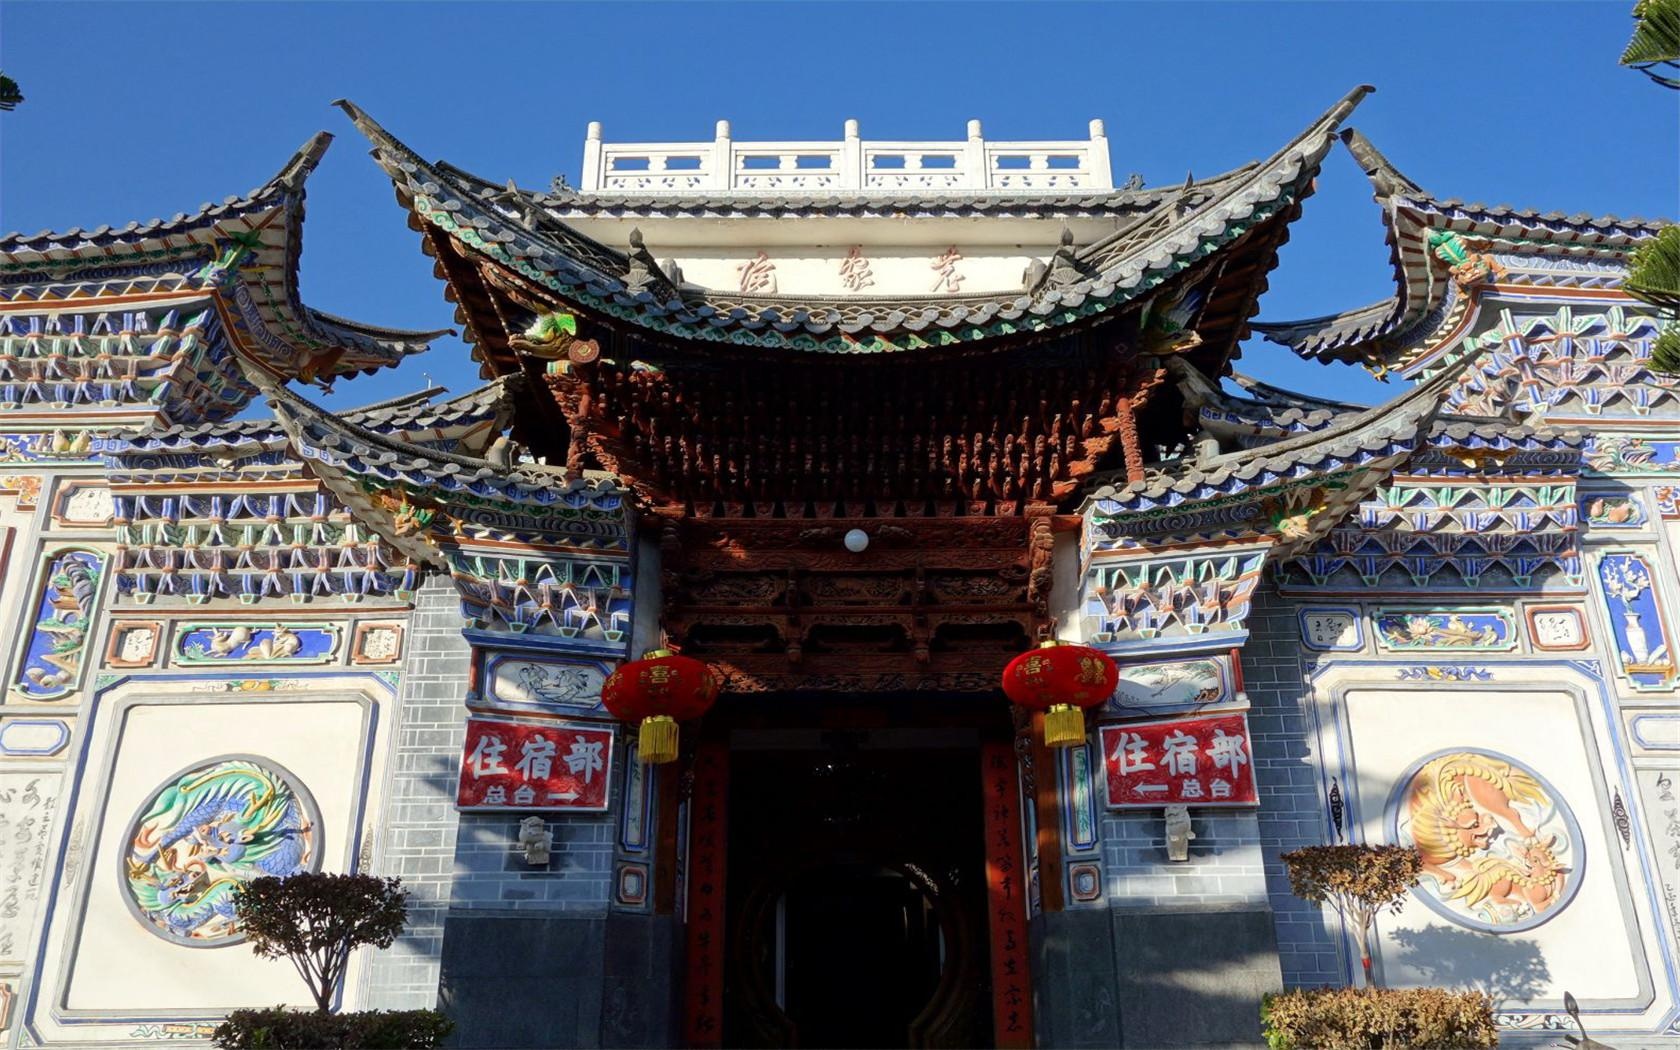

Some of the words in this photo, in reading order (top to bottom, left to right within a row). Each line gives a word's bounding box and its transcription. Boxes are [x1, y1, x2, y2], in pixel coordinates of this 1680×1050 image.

[467, 734, 604, 784] 住宿部
[1111, 729, 1247, 779] 住宿部
[483, 785, 536, 804] 总台
[1181, 779, 1232, 798] 总台
